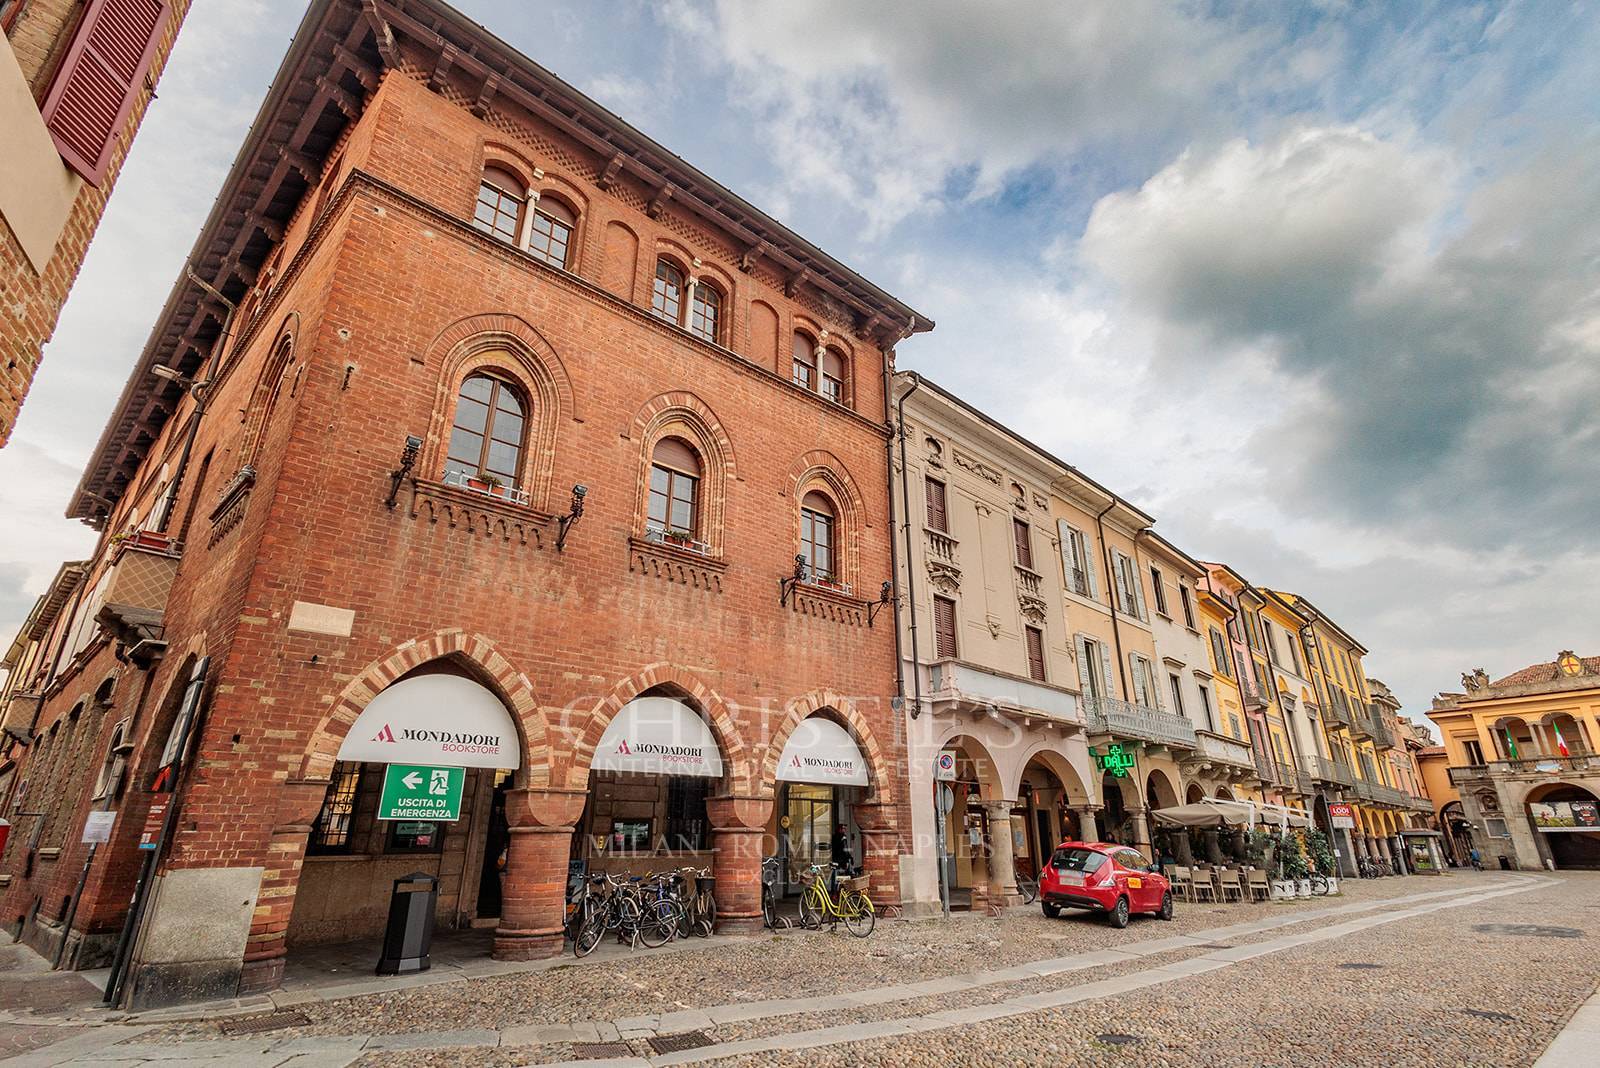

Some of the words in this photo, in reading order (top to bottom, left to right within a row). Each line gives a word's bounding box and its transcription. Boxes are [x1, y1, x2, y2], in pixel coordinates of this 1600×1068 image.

[400, 728, 500, 746] MONDADORI
[442, 743, 500, 755] BOOKSTORE
[633, 743, 702, 757] MONDADORI
[662, 754, 703, 764] BOOKSTORE
[803, 757, 853, 769] MONDADORI
[397, 798, 434, 808] USCITA
[436, 799, 447, 808] DI
[390, 809, 452, 819] EMERGENZA
